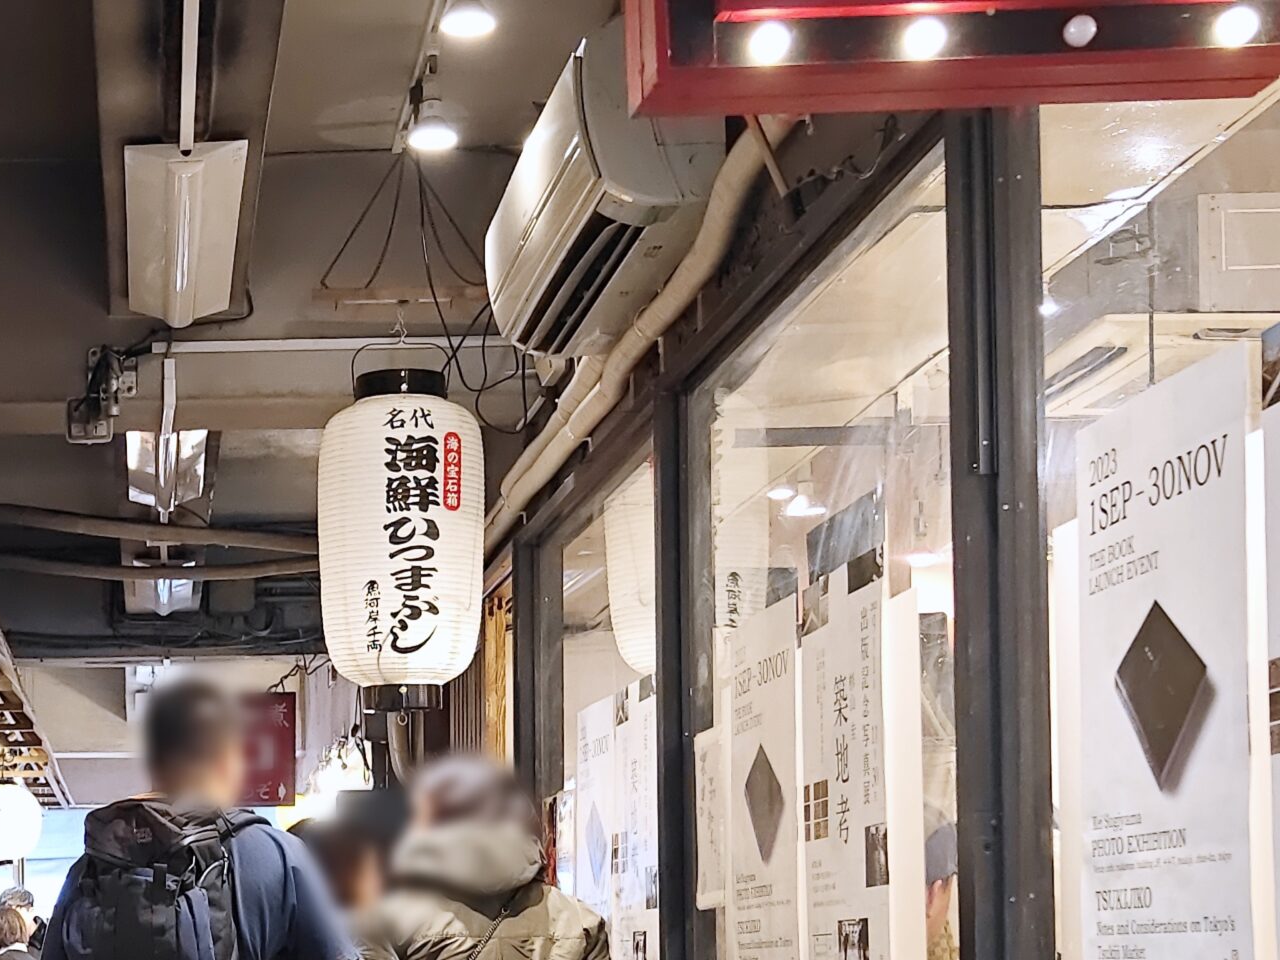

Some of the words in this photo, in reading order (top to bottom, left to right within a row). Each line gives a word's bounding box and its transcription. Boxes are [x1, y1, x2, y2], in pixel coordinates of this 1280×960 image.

[383, 406, 435, 430] 名代
[445, 434, 460, 509] 海の宝石箱
[1089, 448, 1118, 487] 2023
[383, 434, 440, 654] 海鮮ひつまぶし
[1088, 548, 1106, 571] THE
[1108, 535, 1135, 563] BOOK
[1126, 550, 1159, 580] EVENT
[833, 674, 850, 845] 築地考
[1091, 837, 1124, 857] PHOTO
[1127, 828, 1186, 854] EXHIBITION
[1117, 920, 1130, 935] and
[1131, 918, 1188, 934] Considerations
